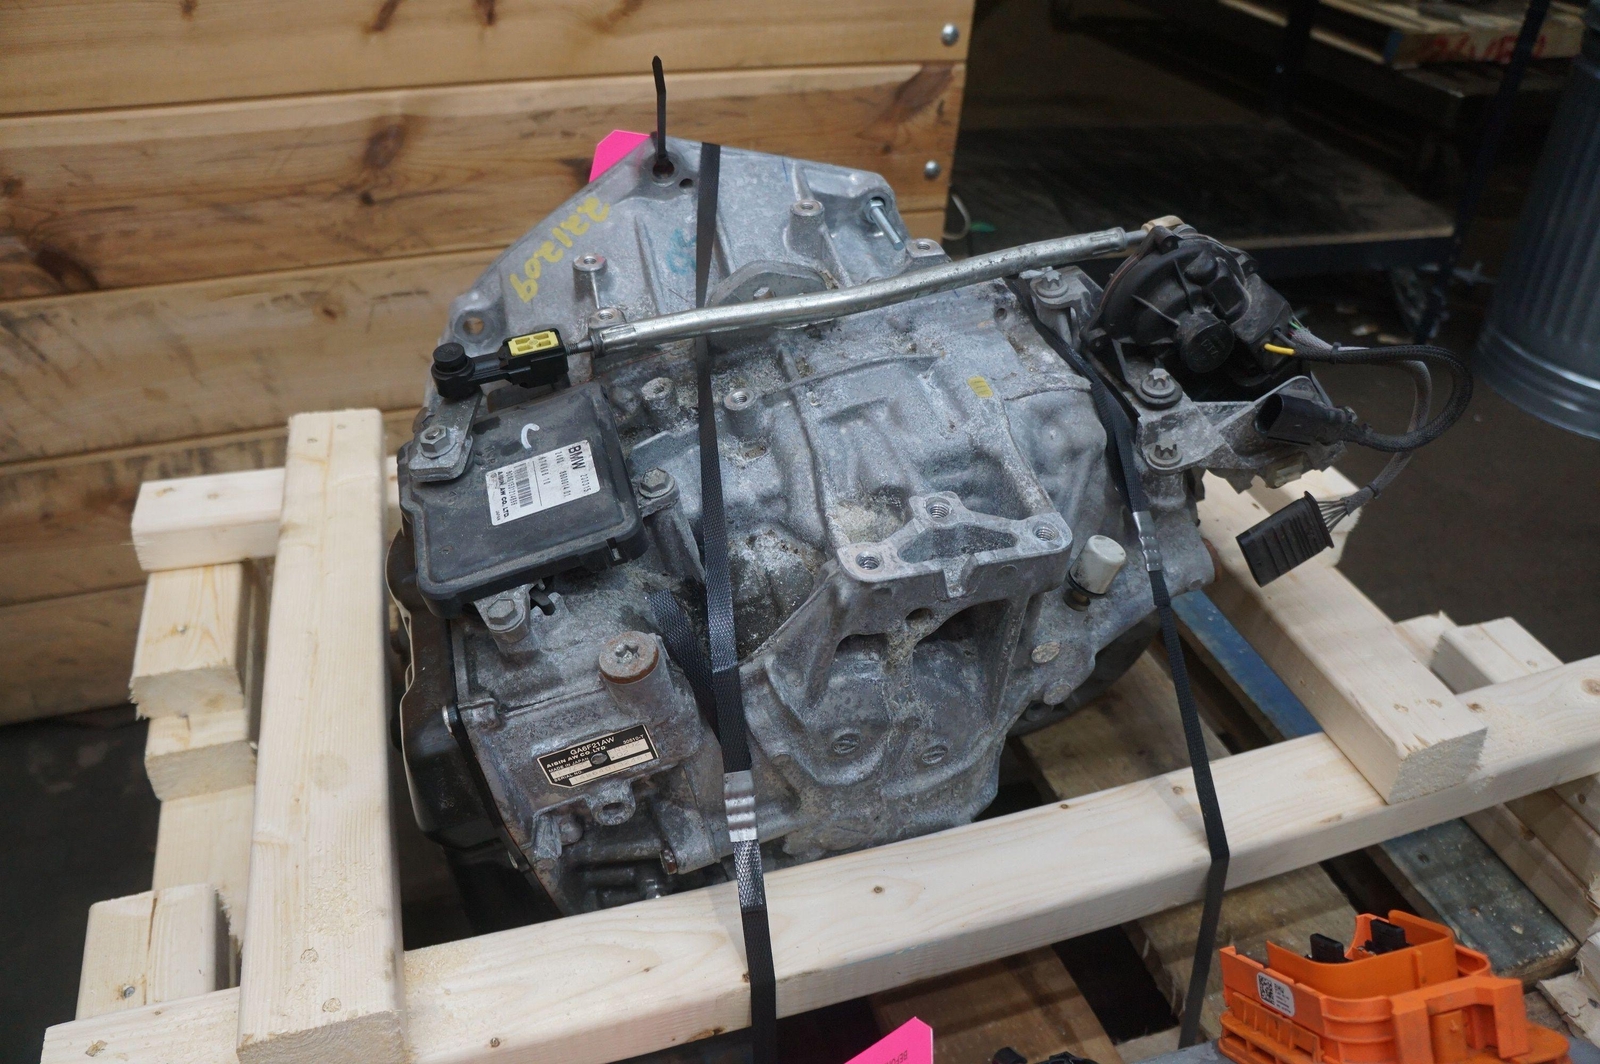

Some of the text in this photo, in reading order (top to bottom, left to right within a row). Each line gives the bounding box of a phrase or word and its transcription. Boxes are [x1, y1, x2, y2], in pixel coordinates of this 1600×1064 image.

[511, 198, 609, 302] 221209
[568, 445, 586, 470] BMW
[500, 487, 506, 496] AW
[570, 737, 615, 754] GA6F21AW
[546, 759, 566, 768] AISIN
[572, 757, 589, 765] JAPAN
